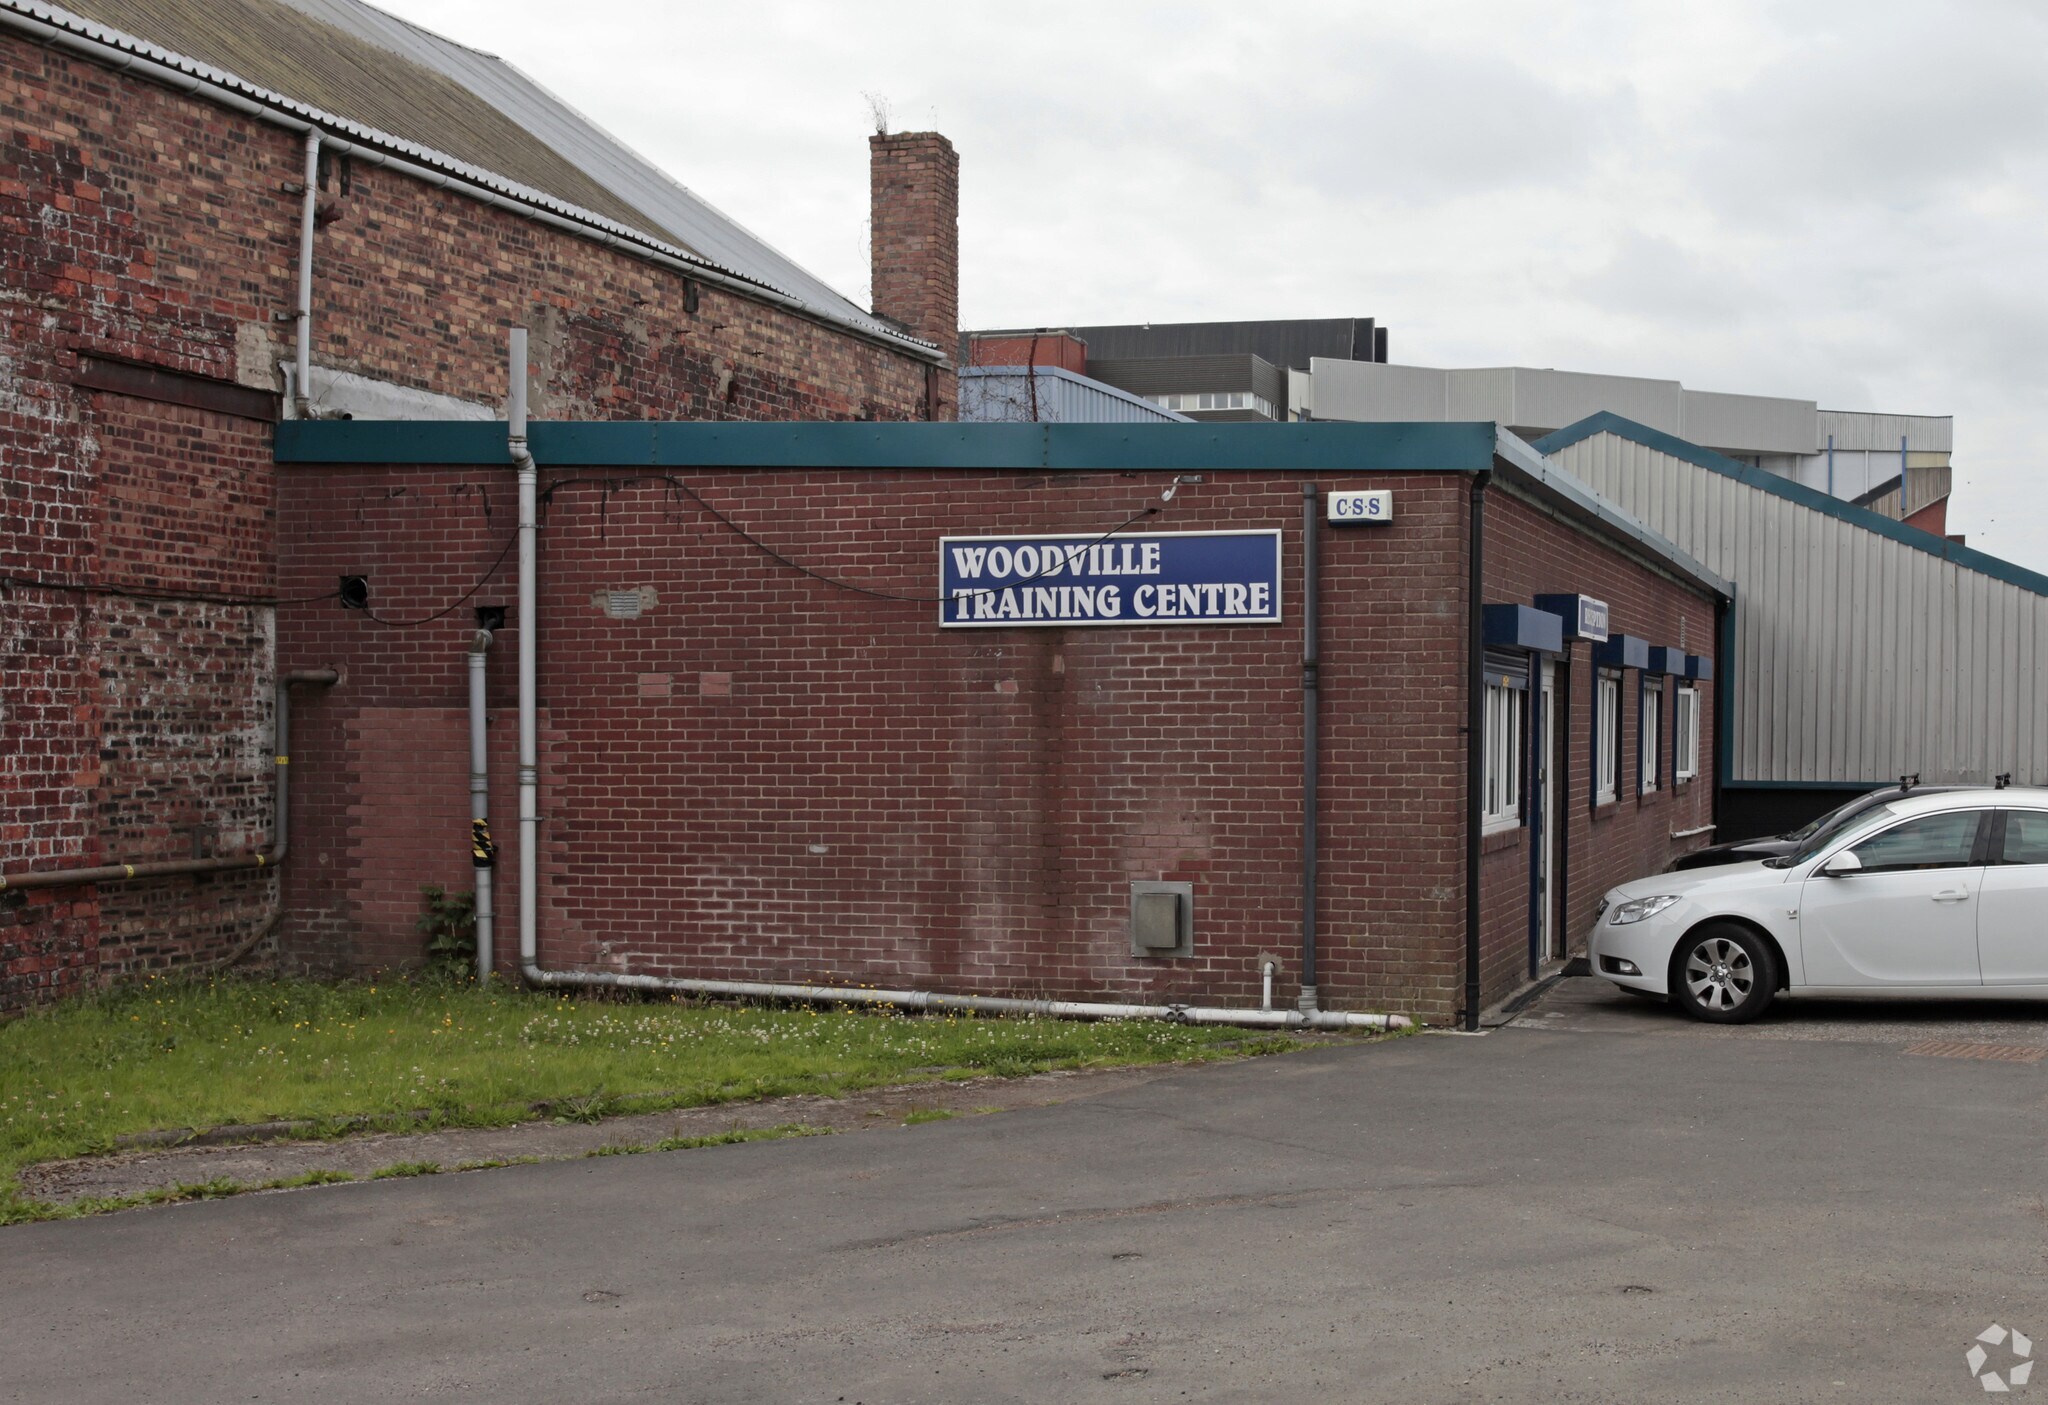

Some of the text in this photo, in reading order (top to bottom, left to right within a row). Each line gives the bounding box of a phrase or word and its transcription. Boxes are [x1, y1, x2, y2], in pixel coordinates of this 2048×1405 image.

[952, 543, 1160, 579] WOODVILLE
[952, 582, 1269, 620] TRAINING CENTRE
